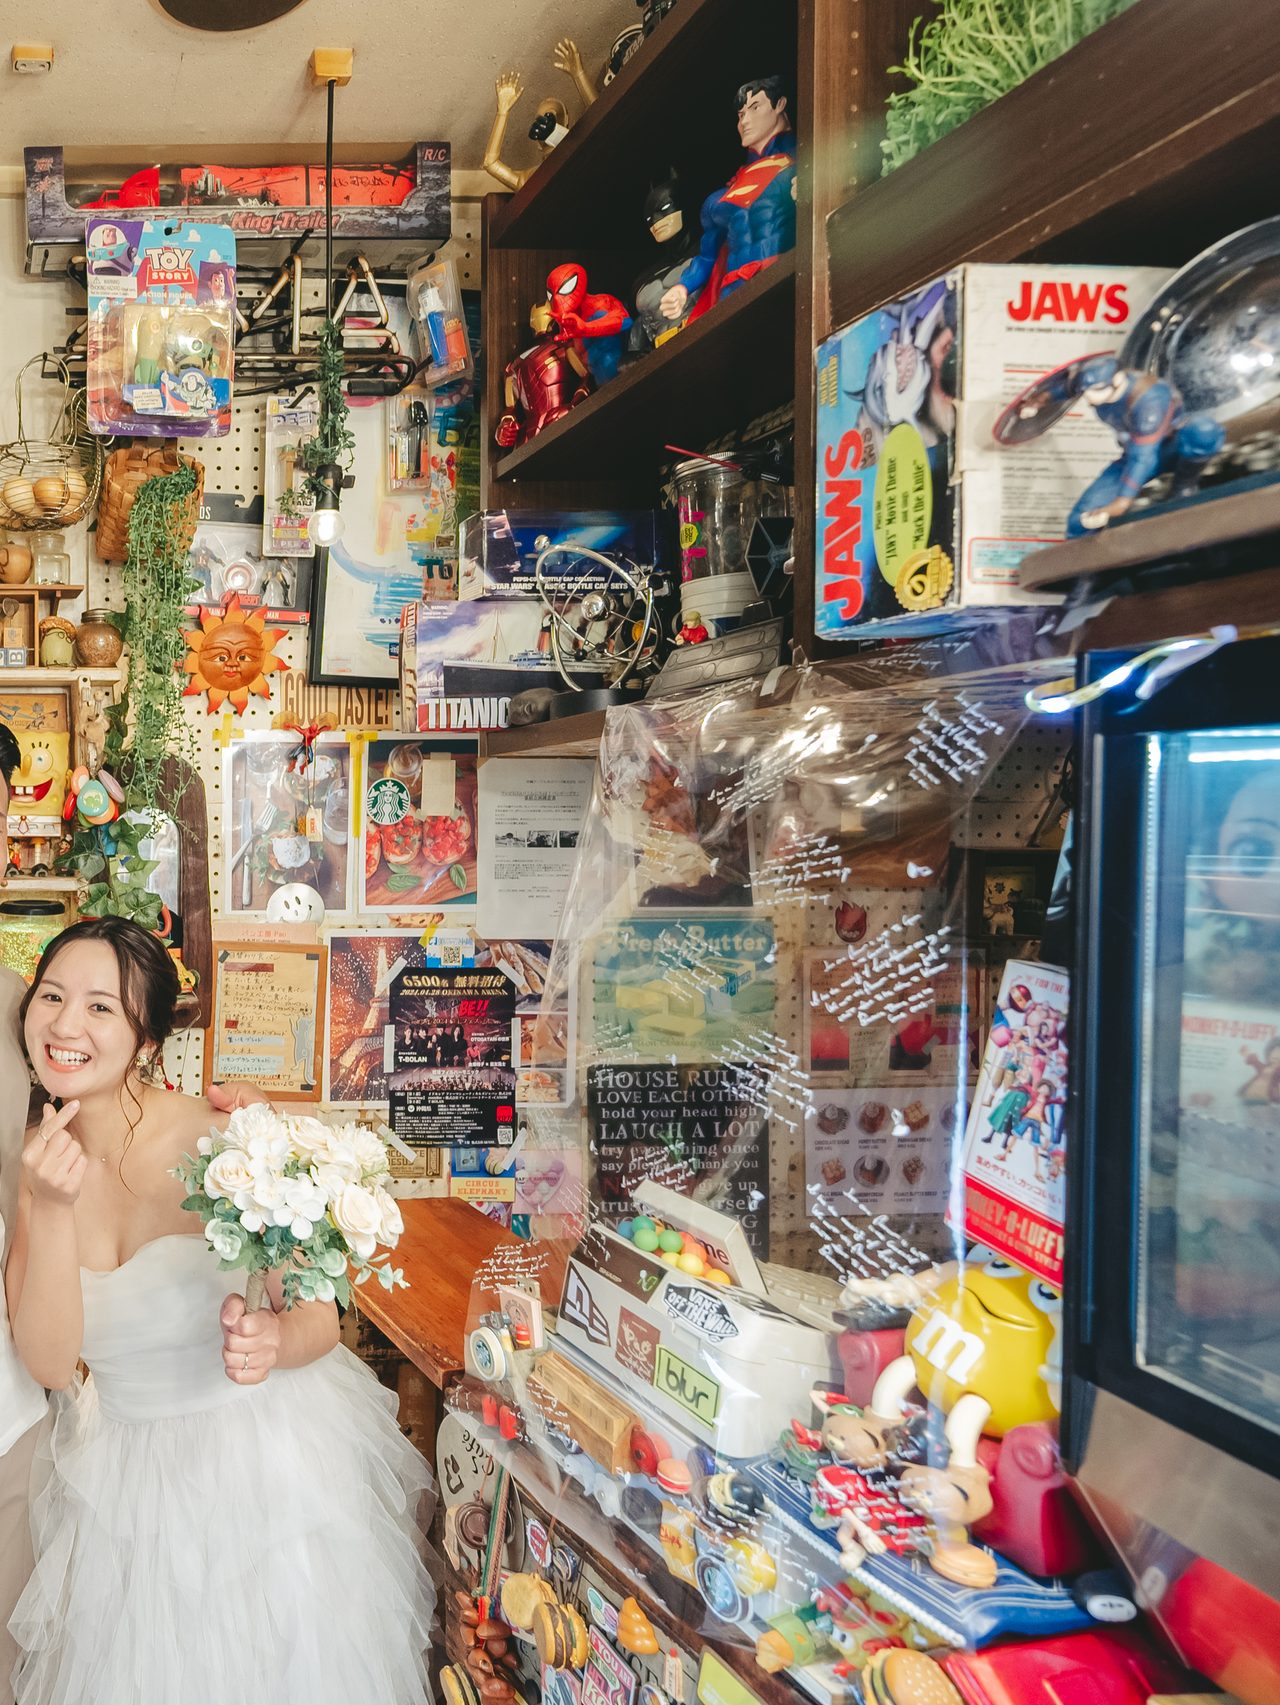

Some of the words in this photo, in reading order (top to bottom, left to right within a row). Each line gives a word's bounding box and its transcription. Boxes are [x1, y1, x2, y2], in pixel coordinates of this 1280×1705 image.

[423, 148, 447, 161] R/C
[145, 248, 194, 270] TOY
[152, 272, 190, 280] STORY
[1007, 281, 1129, 324] JAWS
[886, 456, 897, 491] Theme
[886, 494, 897, 525] Movie
[823, 429, 864, 620] JAWS
[406, 602, 417, 649] TITANIC
[424, 697, 512, 729] TITANIC
[441, 988, 480, 996] OKINAWA
[453, 975, 506, 988] 無料招待
[458, 999, 490, 1017] BE!!
[597, 1070, 679, 1089] HOUSE
[597, 1091, 642, 1104] LOVE
[649, 1090, 696, 1103] EACH
[602, 1107, 635, 1119] hold
[641, 1109, 677, 1120] your
[682, 1106, 718, 1117] head
[724, 1106, 758, 1118] high
[600, 1122, 684, 1140] LAUGH
[692, 1122, 705, 1138] A
[714, 1120, 760, 1138] LOT
[601, 1144, 625, 1159] try
[723, 1145, 760, 1154] once
[601, 1162, 626, 1172] say
[734, 1160, 759, 1171] you
[738, 1181, 758, 1194] up
[688, 1288, 720, 1313] VANS
[684, 1303, 706, 1329] THE
[911, 1308, 986, 1386] m
[665, 1357, 709, 1409] blur
[600, 1643, 620, 1670] YOU
